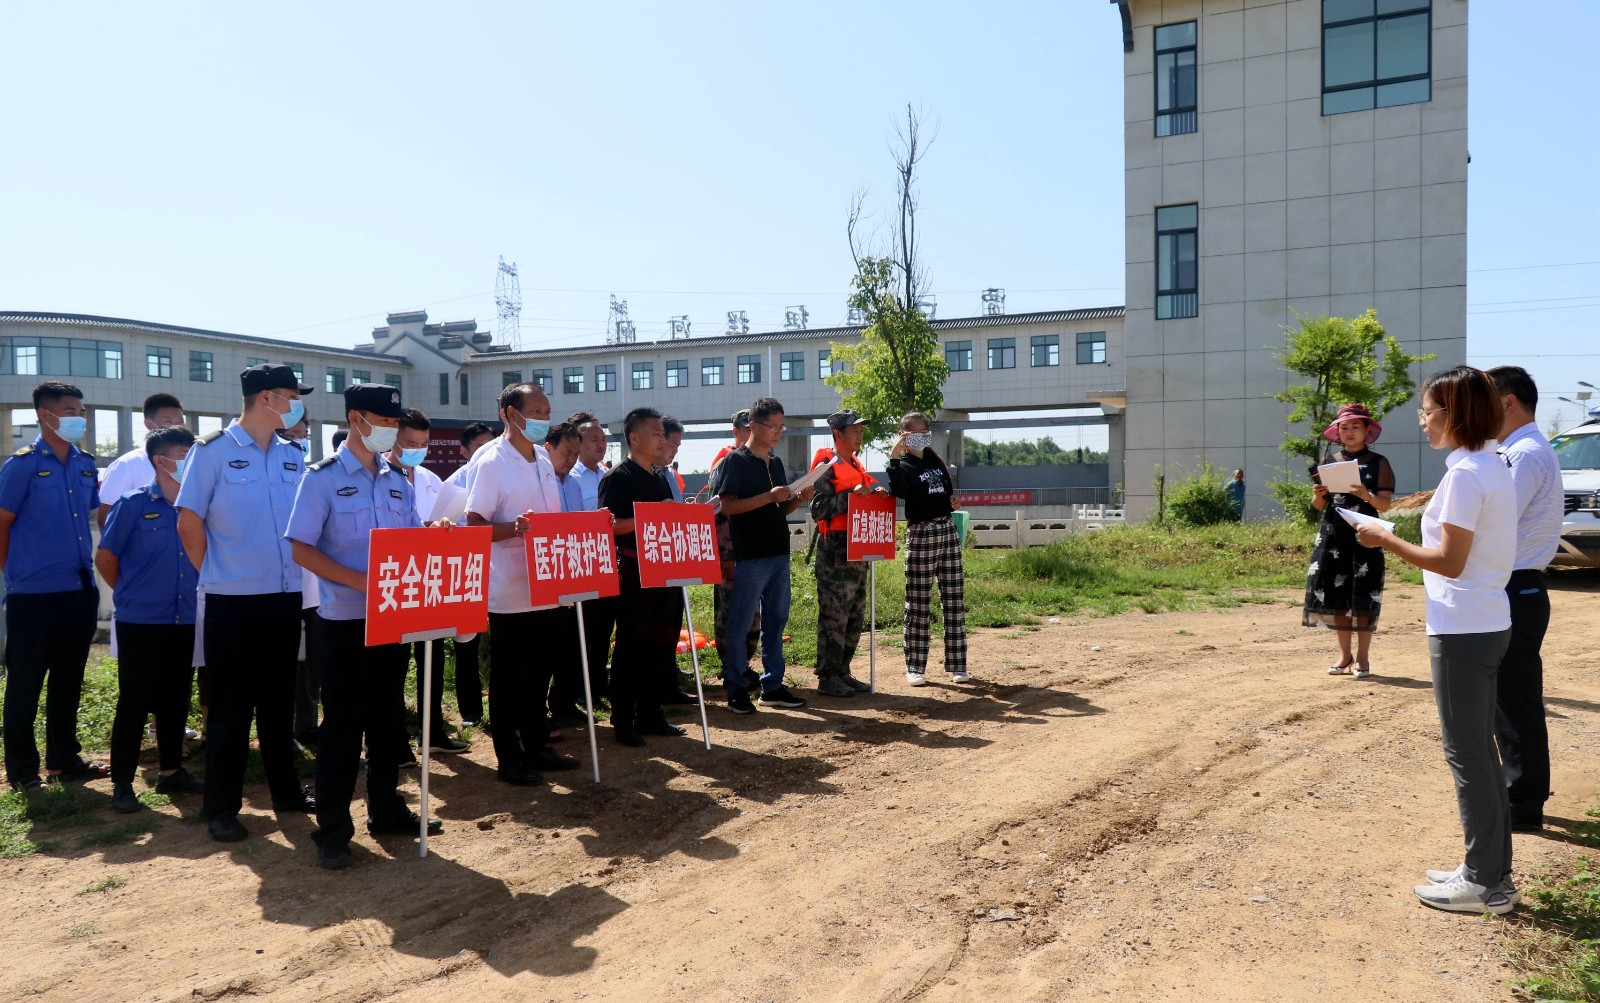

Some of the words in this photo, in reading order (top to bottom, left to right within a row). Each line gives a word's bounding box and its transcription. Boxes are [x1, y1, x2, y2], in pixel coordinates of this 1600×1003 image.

[643, 521, 716, 564] 综合协调组
[852, 509, 894, 544] 应急救援组
[533, 532, 614, 581] 医疗救护组
[378, 551, 484, 613] 安全保卫组
